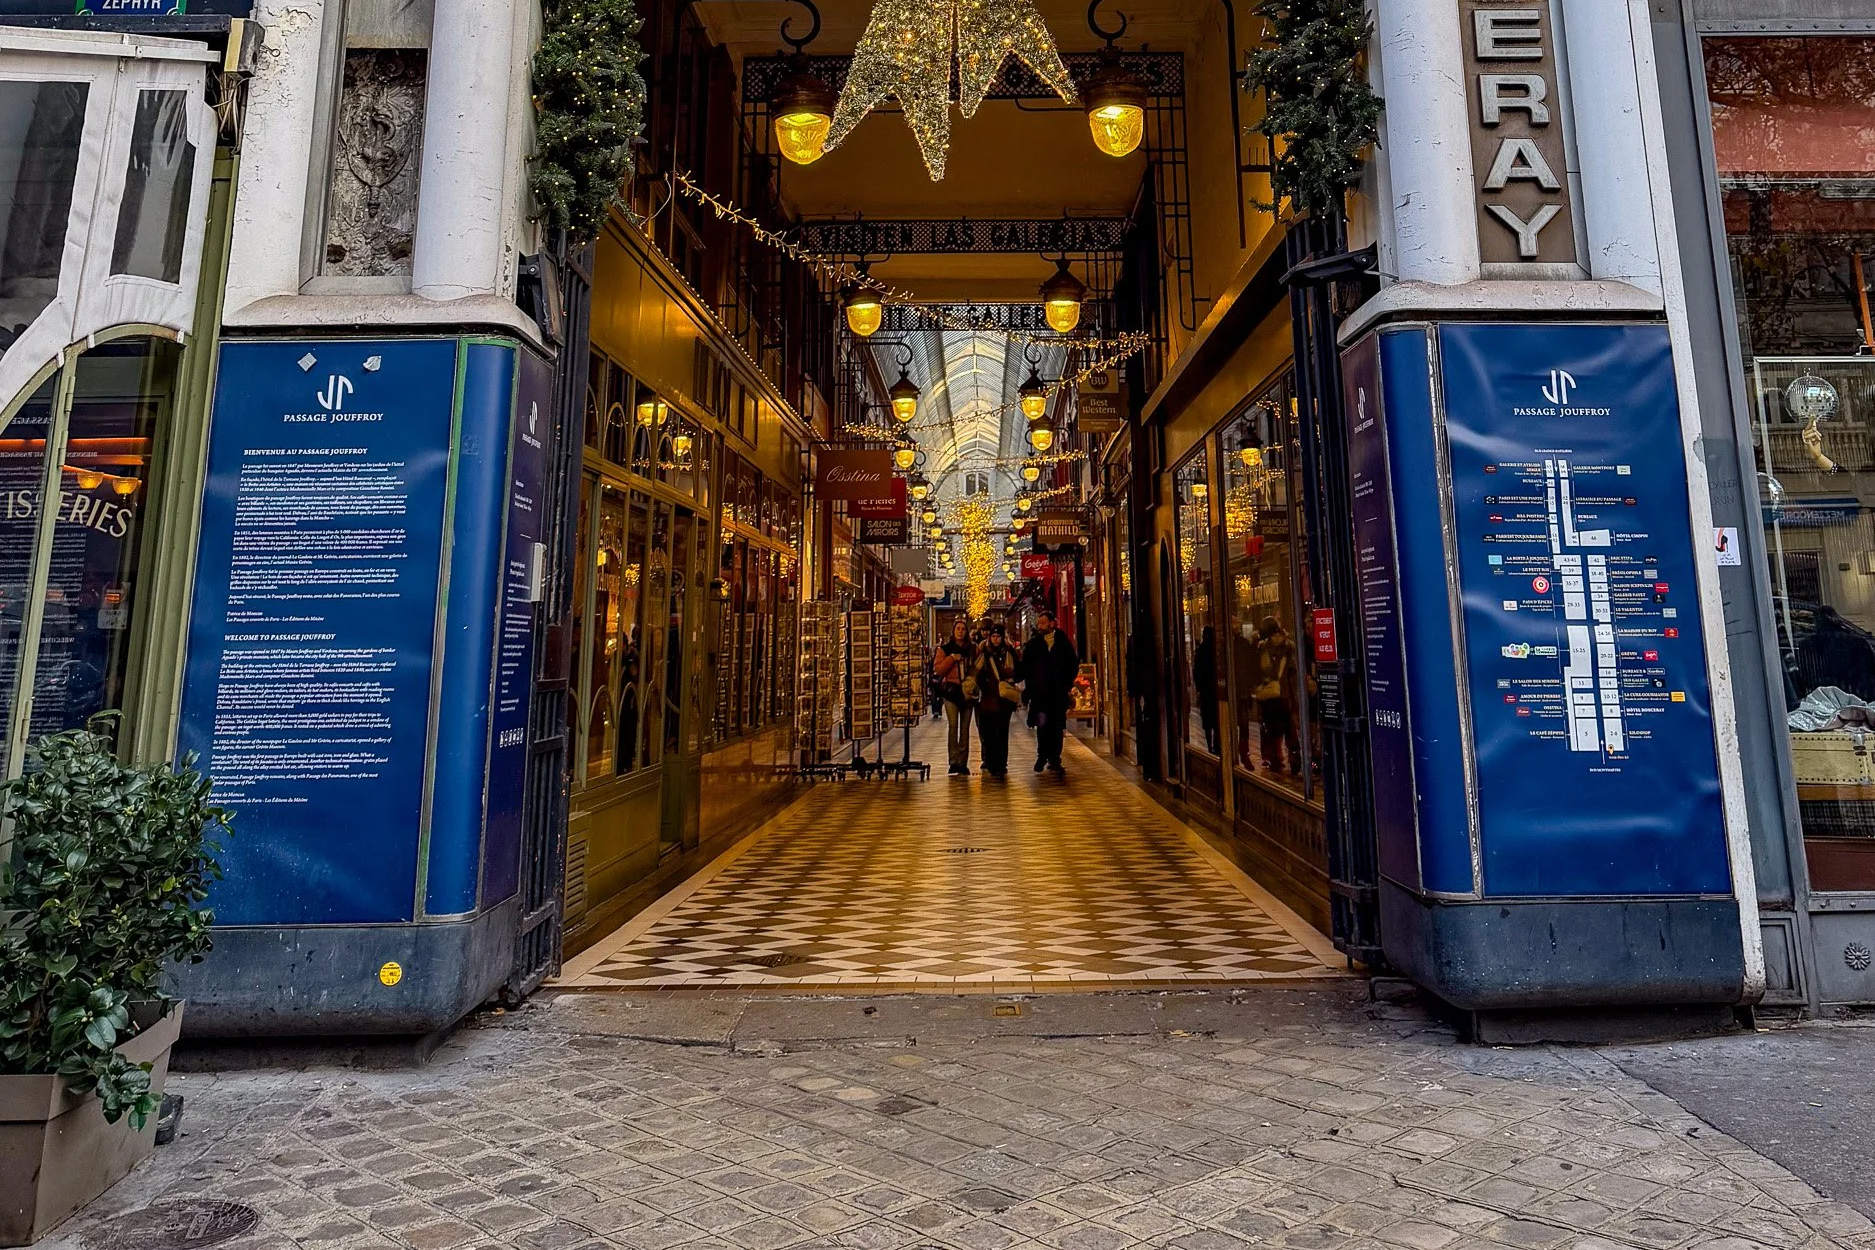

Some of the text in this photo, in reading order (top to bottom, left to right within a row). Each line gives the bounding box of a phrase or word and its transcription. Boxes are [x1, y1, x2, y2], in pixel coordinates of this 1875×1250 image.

[930, 225, 977, 249] LAS
[1091, 376, 1107, 385] BW
[1090, 398, 1108, 406] Best
[1513, 407, 1611, 417] PASSAGE JOUFFROY
[283, 412, 384, 423] PASSAGE JOUFFROY
[329, 448, 368, 456] JOUFFROY
[867, 520, 893, 529] SALON
[865, 528, 900, 536] MIROIRS
[1038, 525, 1079, 536] MATHILD
[300, 633, 336, 642] JOUFFROY
